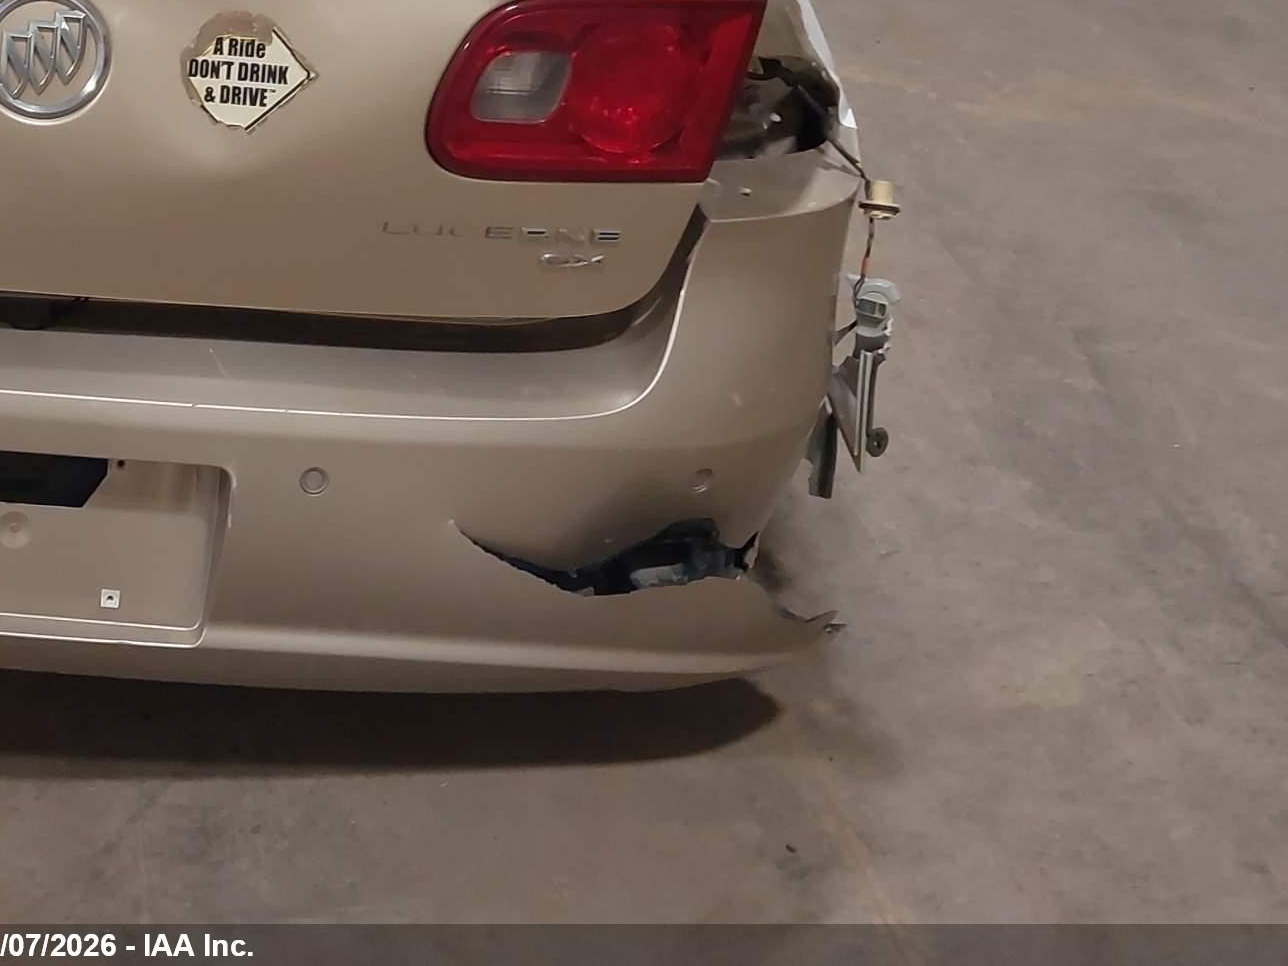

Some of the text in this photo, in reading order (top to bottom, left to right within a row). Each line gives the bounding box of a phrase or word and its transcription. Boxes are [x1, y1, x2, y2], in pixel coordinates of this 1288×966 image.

[213, 36, 266, 59] A Ride
[188, 58, 289, 85] DON'T DRINK
[204, 86, 216, 104] &
[381, 221, 623, 243] LUCERNE
